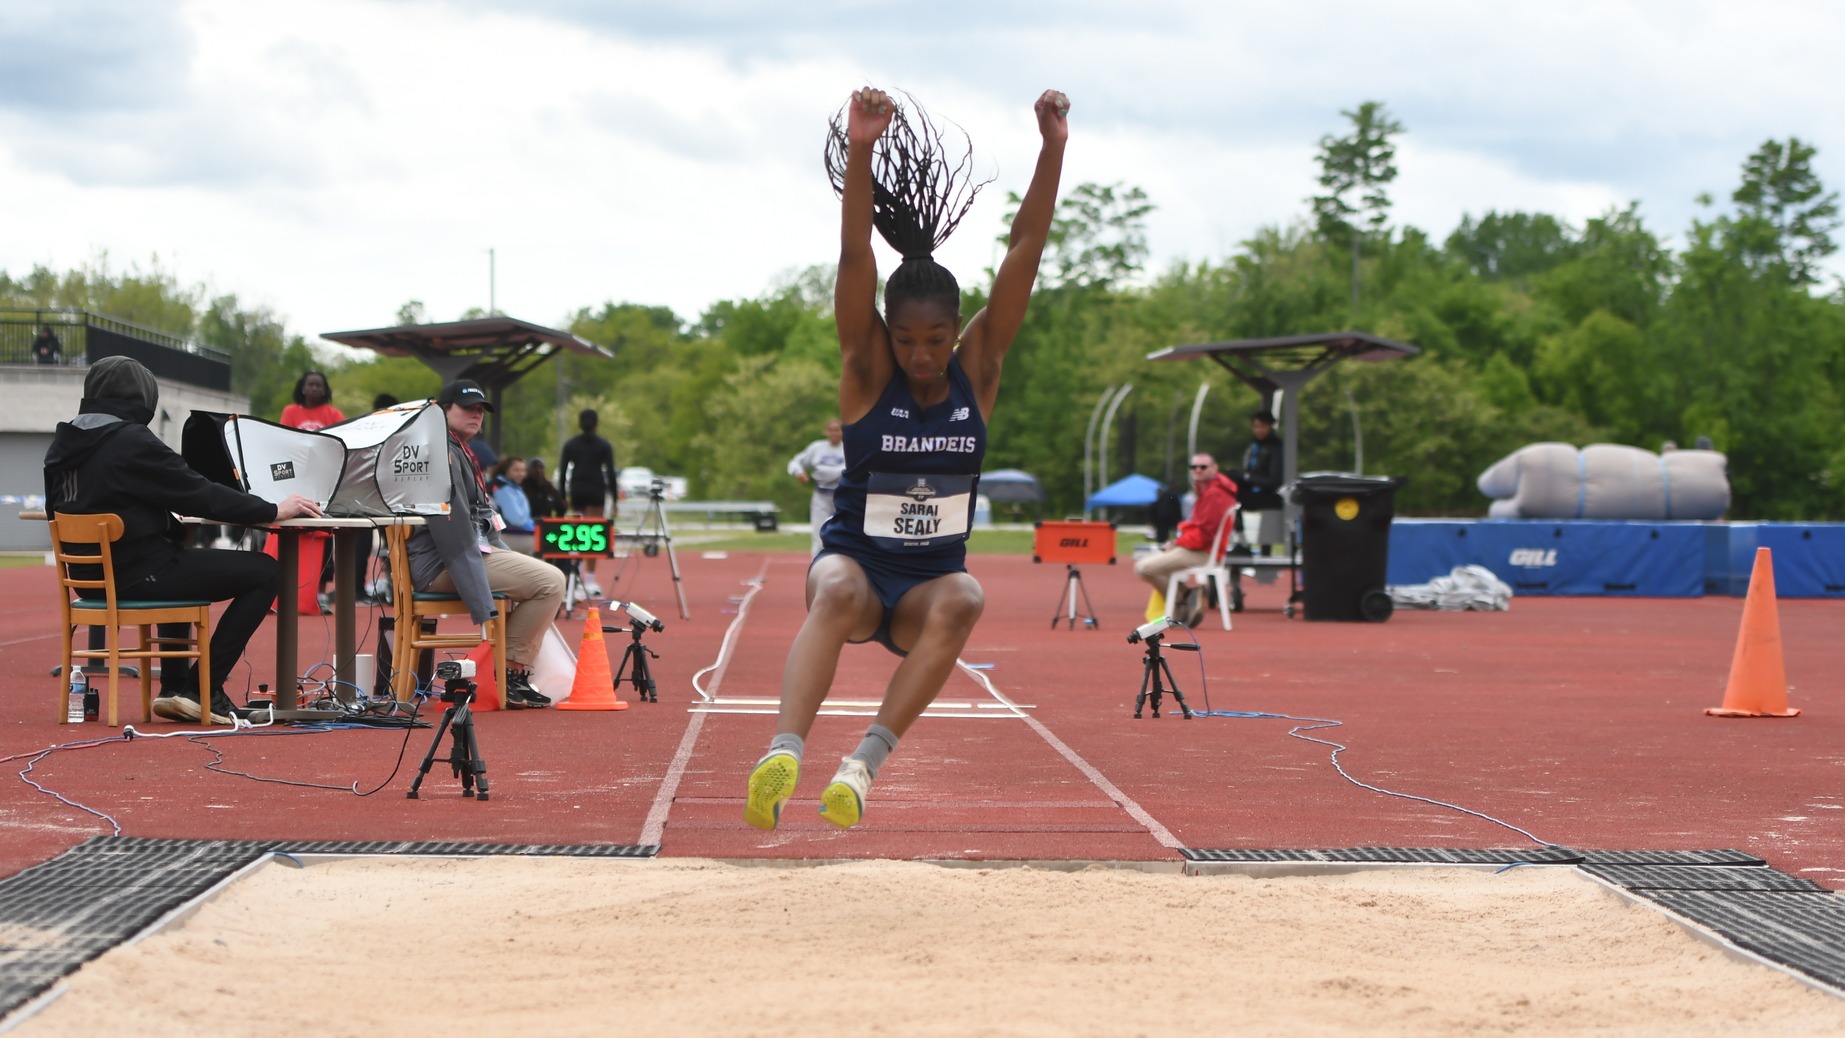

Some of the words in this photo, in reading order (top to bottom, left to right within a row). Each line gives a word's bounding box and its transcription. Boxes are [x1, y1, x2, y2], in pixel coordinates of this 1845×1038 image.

[891, 407, 909, 419] UAA
[881, 435, 976, 453] BRANDEIS
[403, 445, 420, 459] DV
[273, 469, 293, 477] SPORT
[394, 460, 429, 474] SPORT
[900, 503, 938, 516] SARAI
[893, 518, 941, 535] SEALY
[545, 524, 606, 551] +2.95
[1059, 538, 1089, 548] GILL
[1508, 548, 1557, 566] GILL
